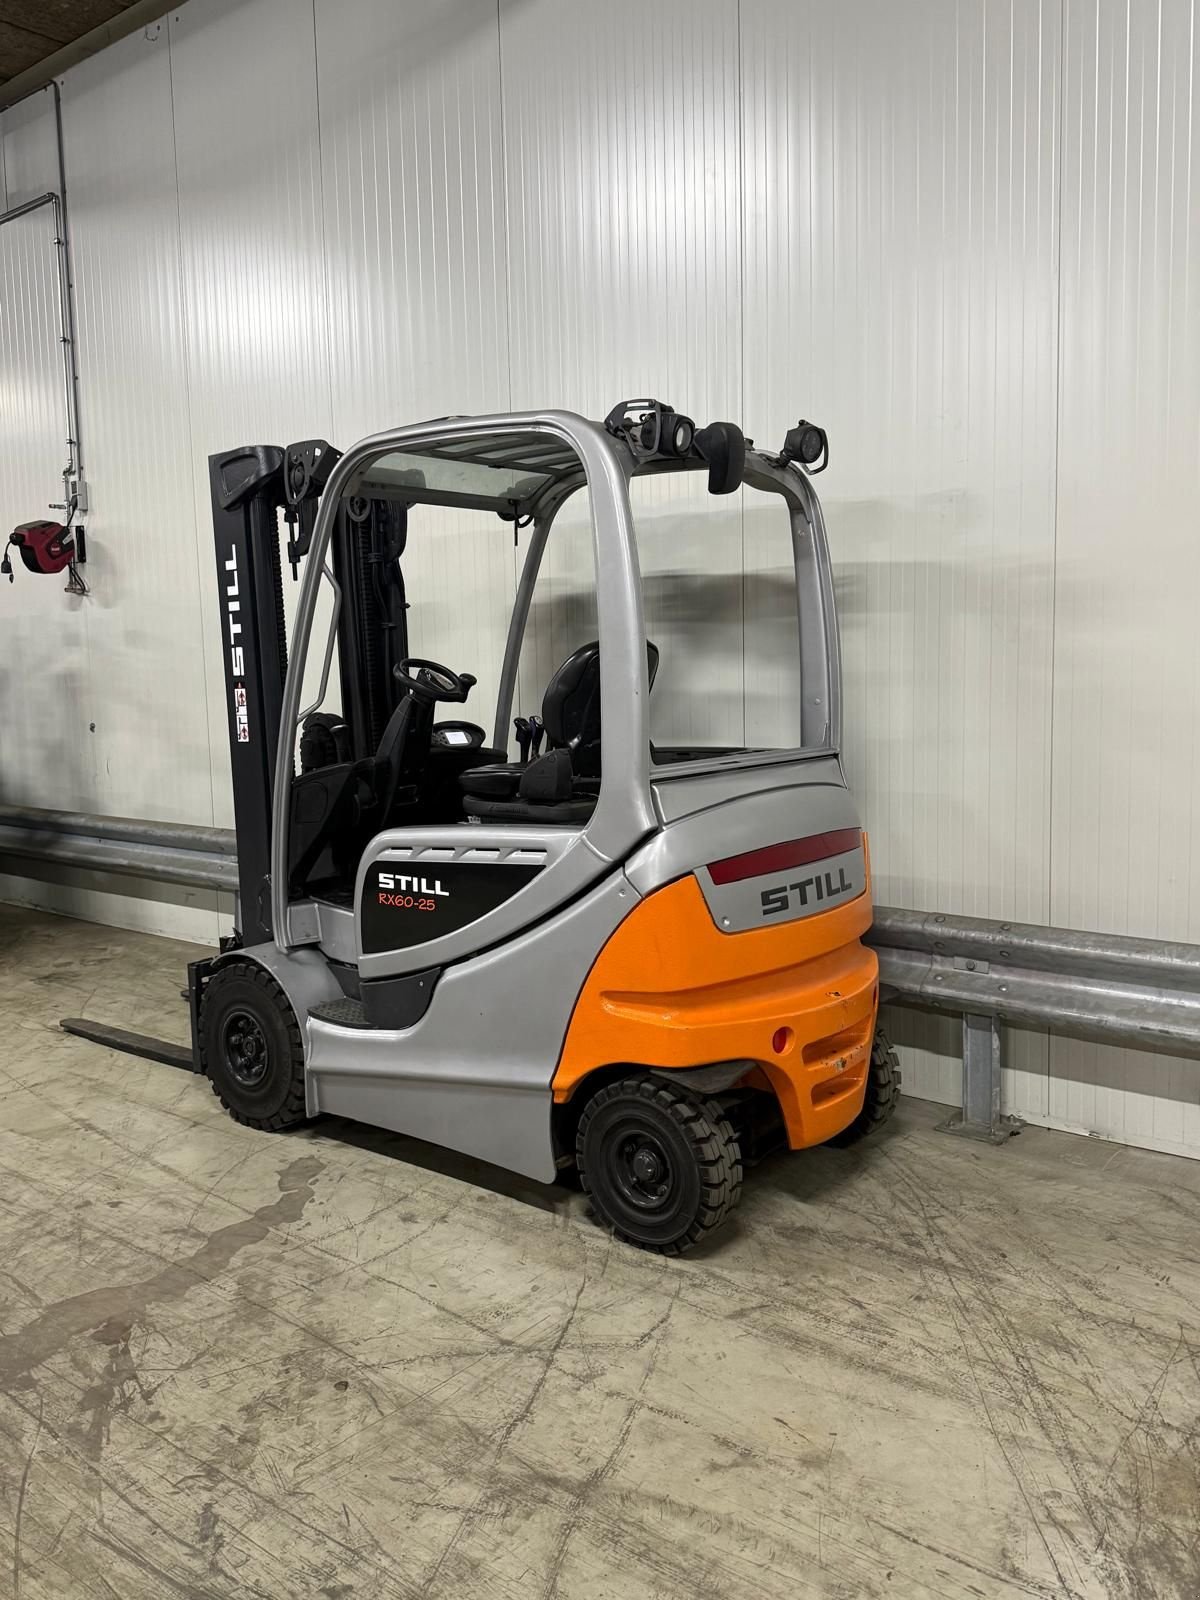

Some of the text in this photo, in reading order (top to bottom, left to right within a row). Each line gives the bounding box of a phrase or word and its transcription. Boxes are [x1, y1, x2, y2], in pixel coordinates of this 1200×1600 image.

[225, 543, 245, 676] STILL
[378, 873, 450, 896] STILL
[378, 893, 436, 911] RX60-25
[760, 868, 852, 916] STILL
